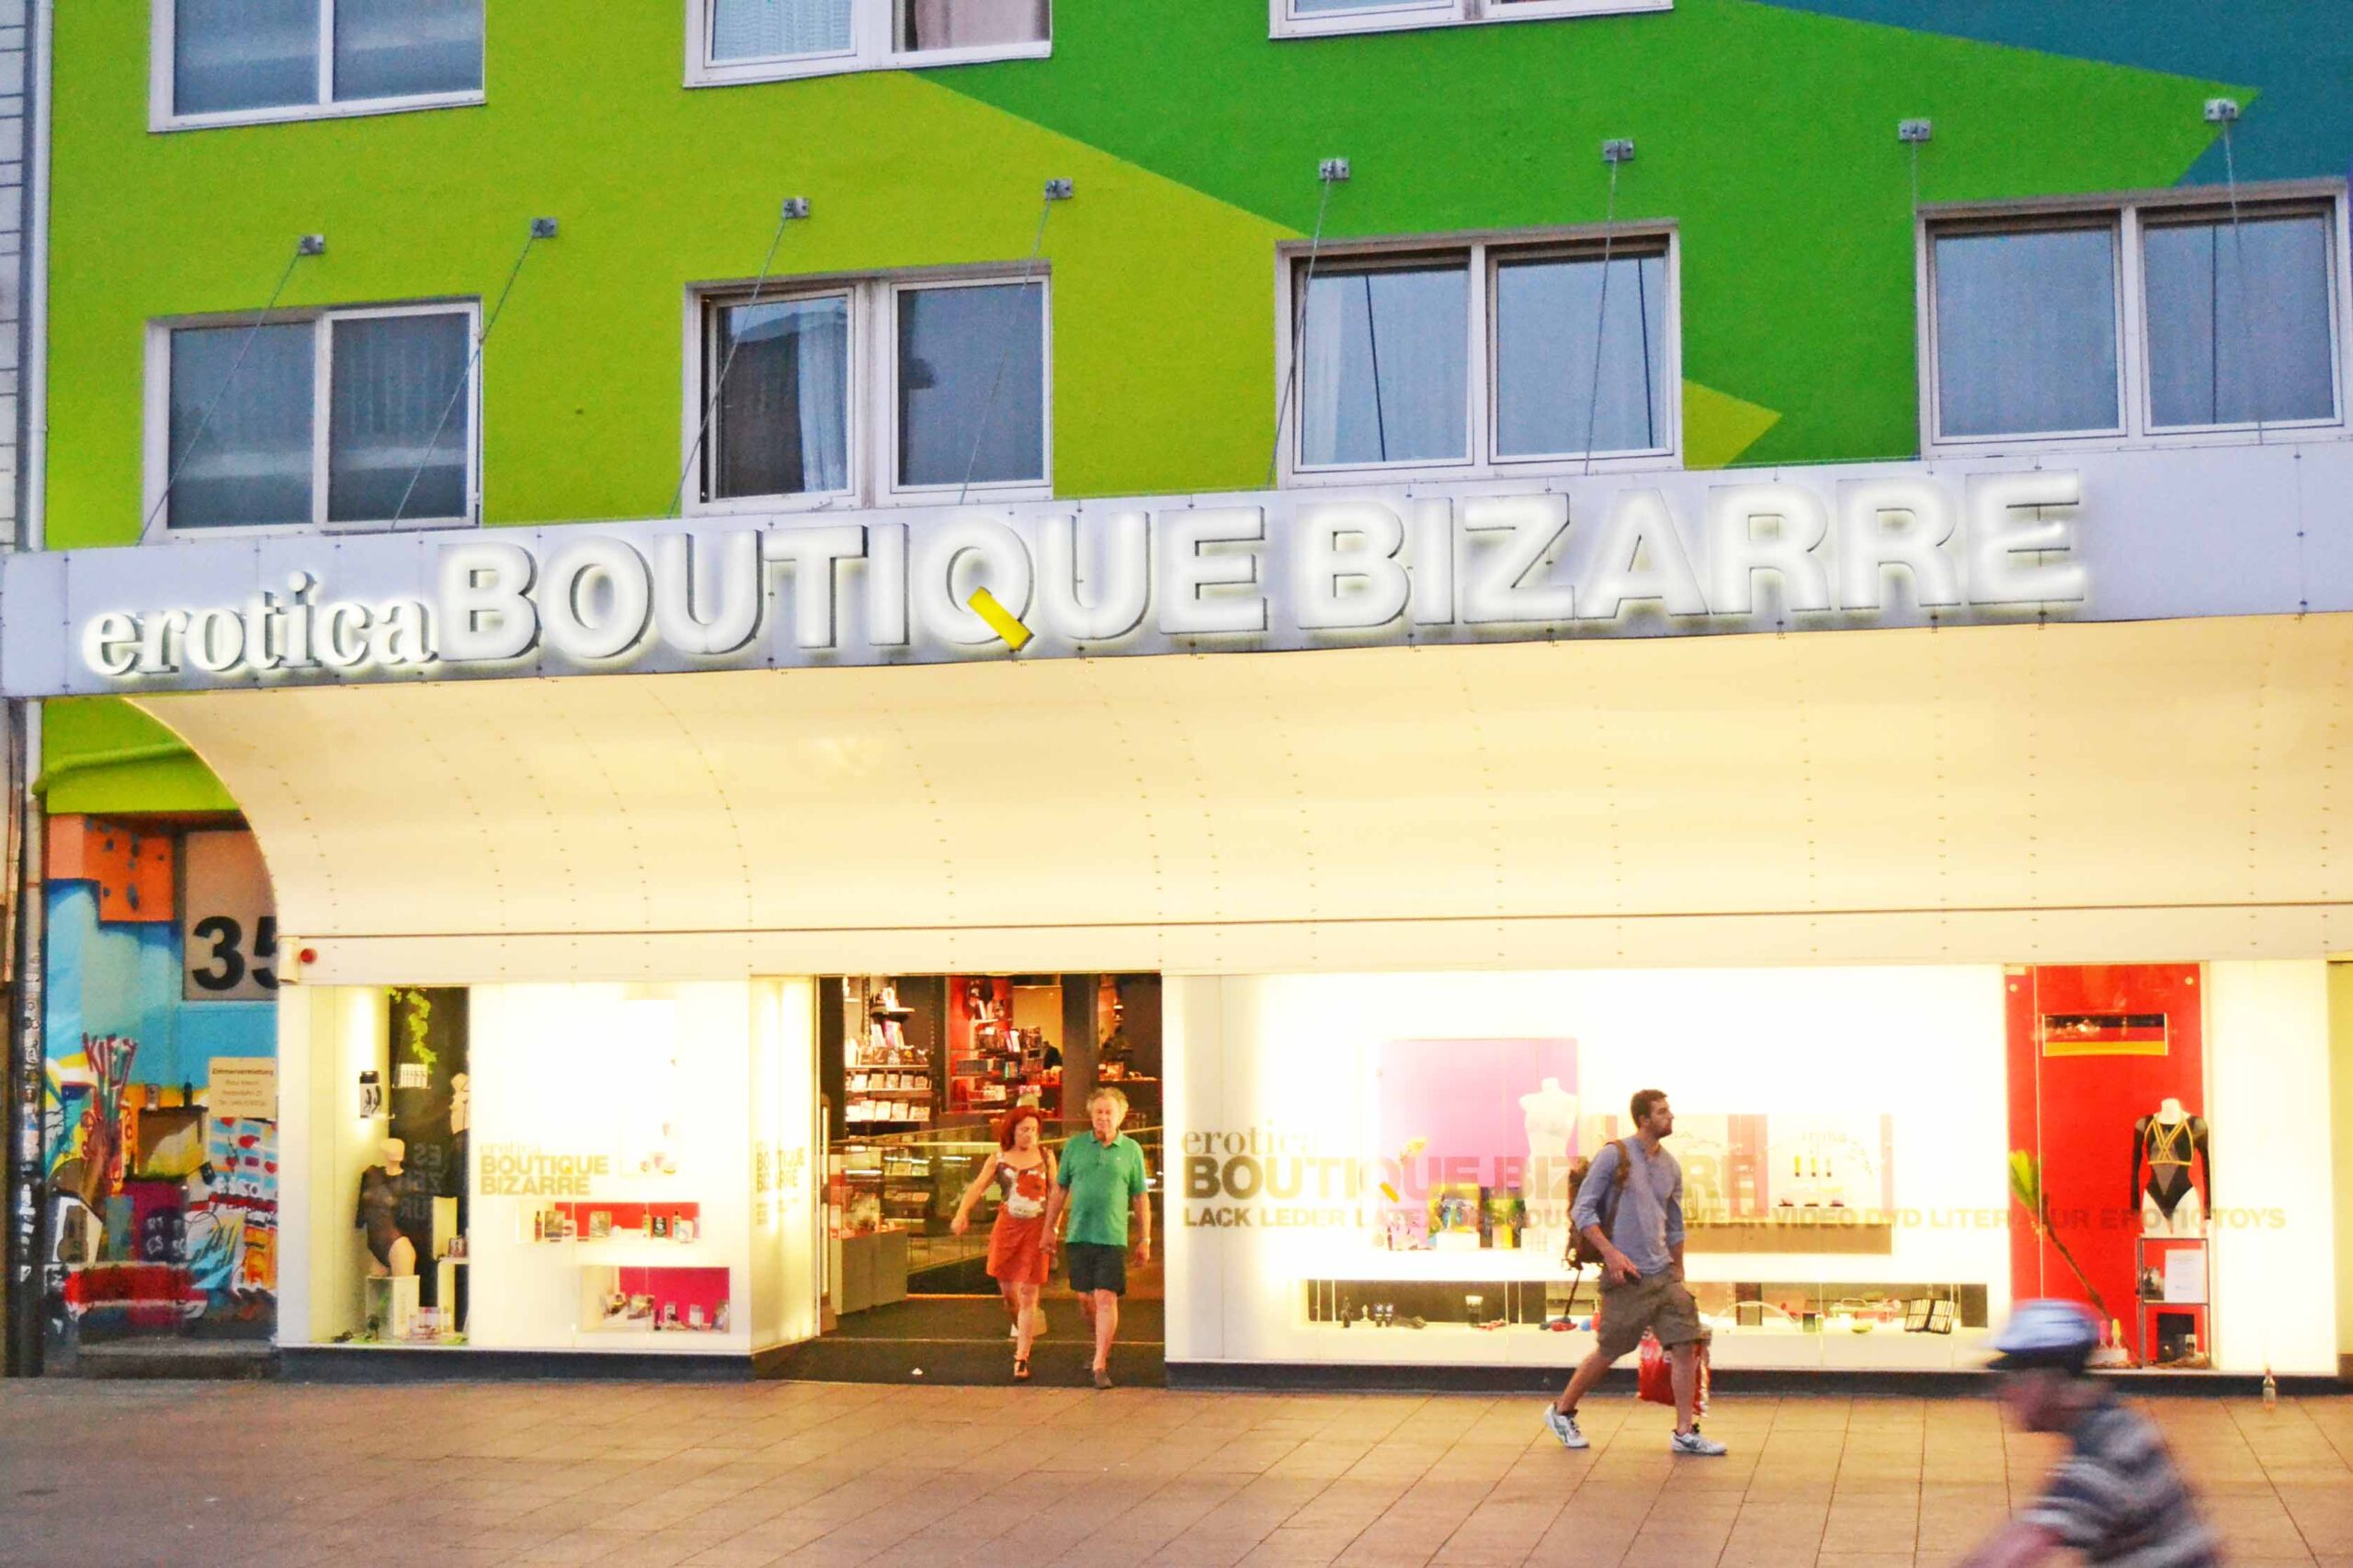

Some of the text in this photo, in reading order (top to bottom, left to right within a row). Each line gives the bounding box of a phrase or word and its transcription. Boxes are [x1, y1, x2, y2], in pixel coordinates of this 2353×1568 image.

[85, 468, 2085, 676] erotica BOUTIQUE BIZARRE
[1181, 1118, 1317, 1154] erotica
[481, 1154, 610, 1175] BOUTIQUE
[1184, 1154, 1757, 1200] BOUTIQUE BIZRE
[481, 1176, 591, 1195] BIZARRE
[1184, 1208, 1253, 1227] LACK
[1260, 1208, 1347, 1227] LEDER
[1771, 1207, 1857, 1227] VIDEO
[2211, 1208, 2286, 1229] TOYS
